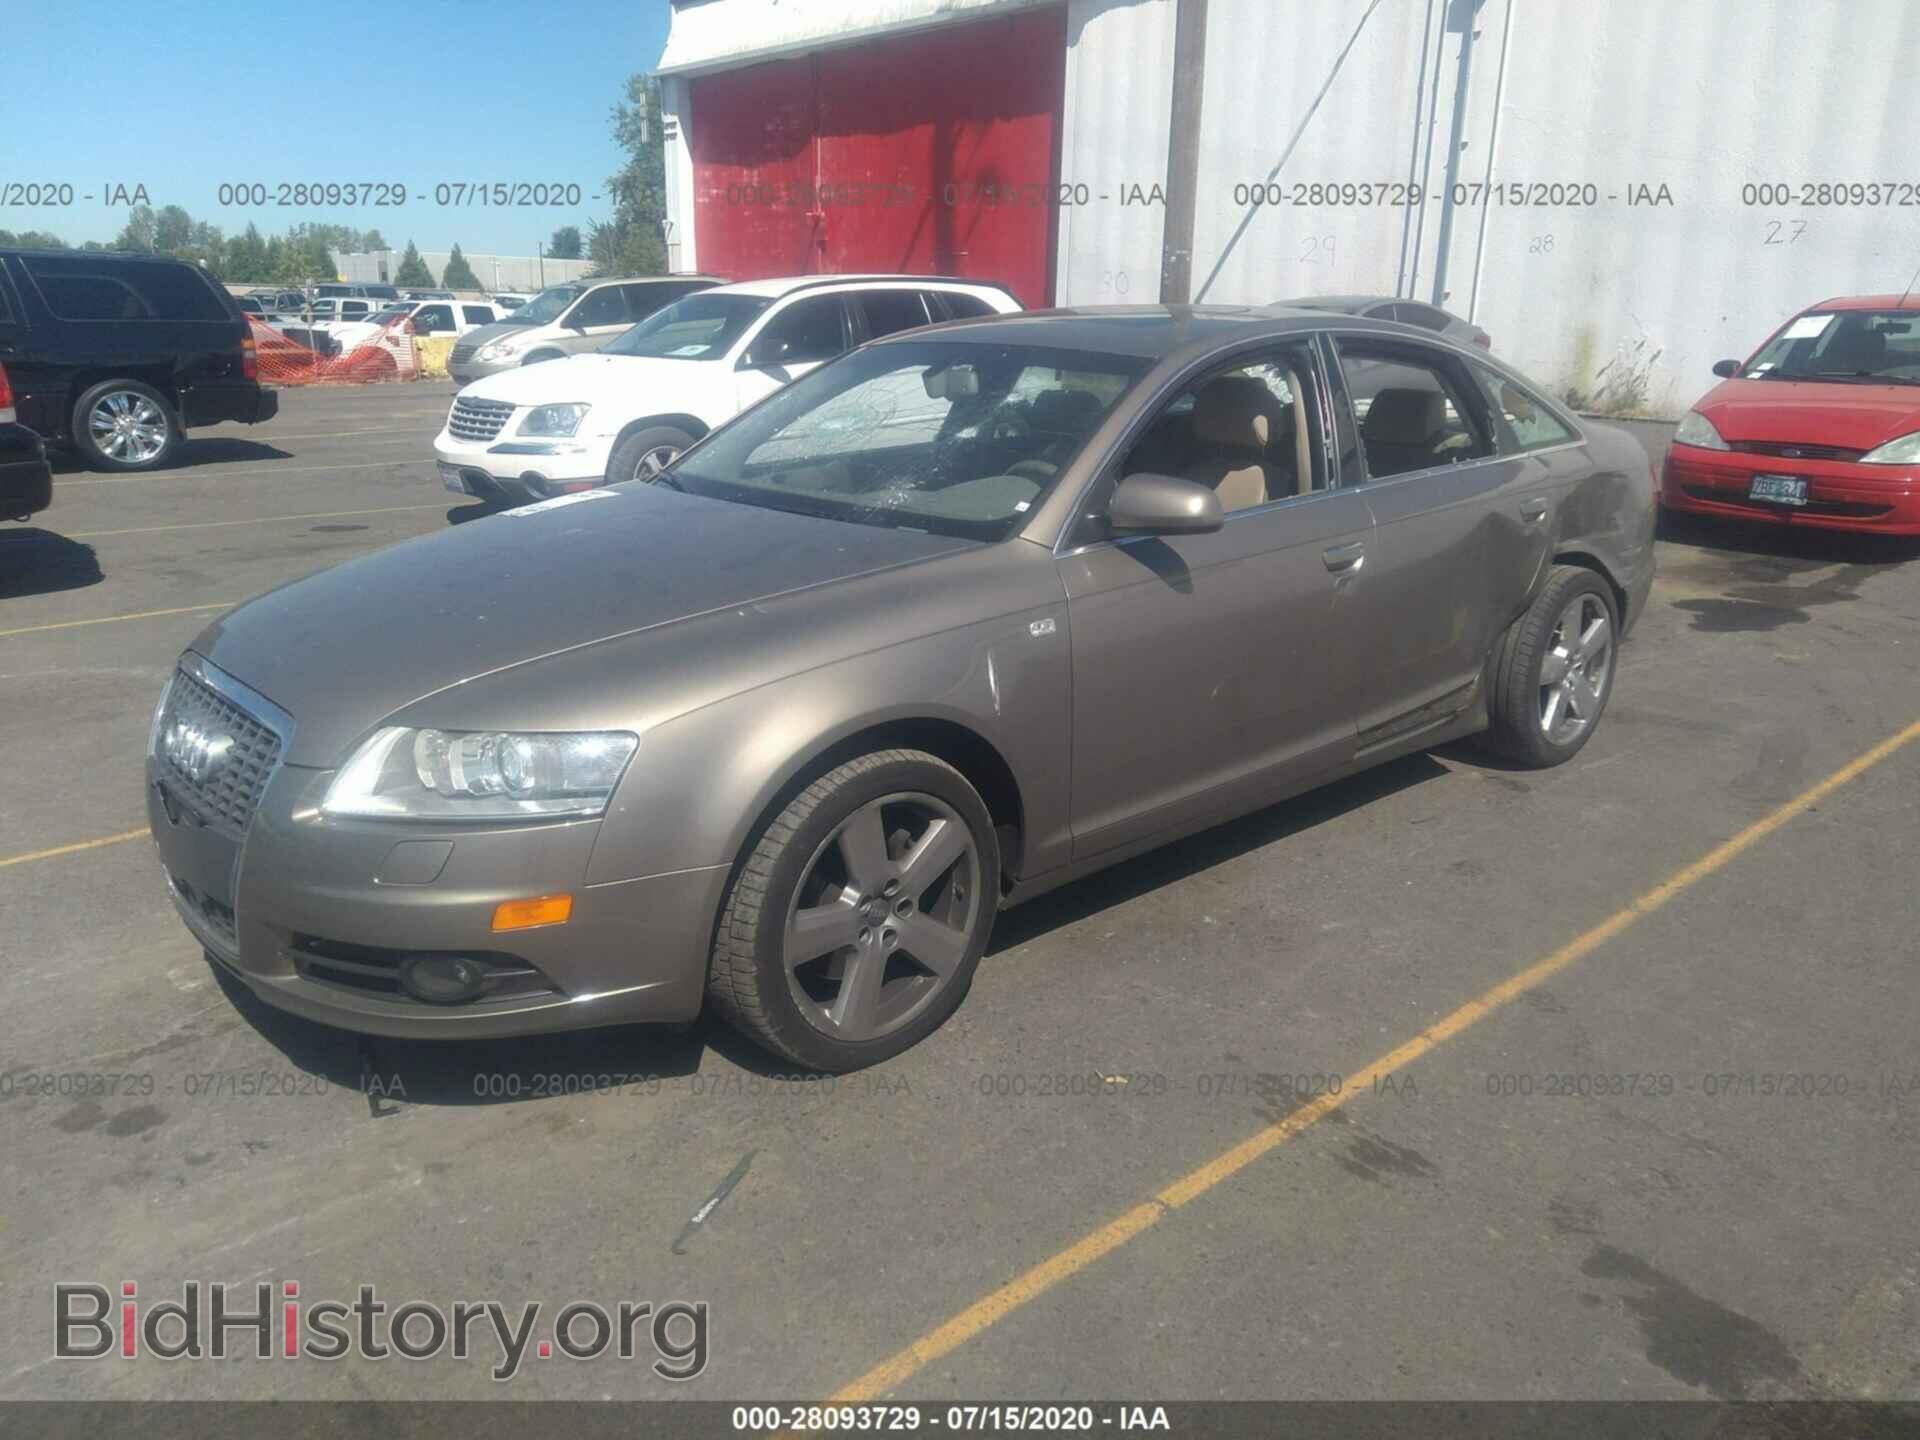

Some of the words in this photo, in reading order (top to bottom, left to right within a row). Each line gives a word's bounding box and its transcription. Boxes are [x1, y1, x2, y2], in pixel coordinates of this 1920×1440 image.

[1528, 233, 1556, 254] 28
[1763, 218, 1810, 246] 27
[1299, 233, 1337, 268] 29
